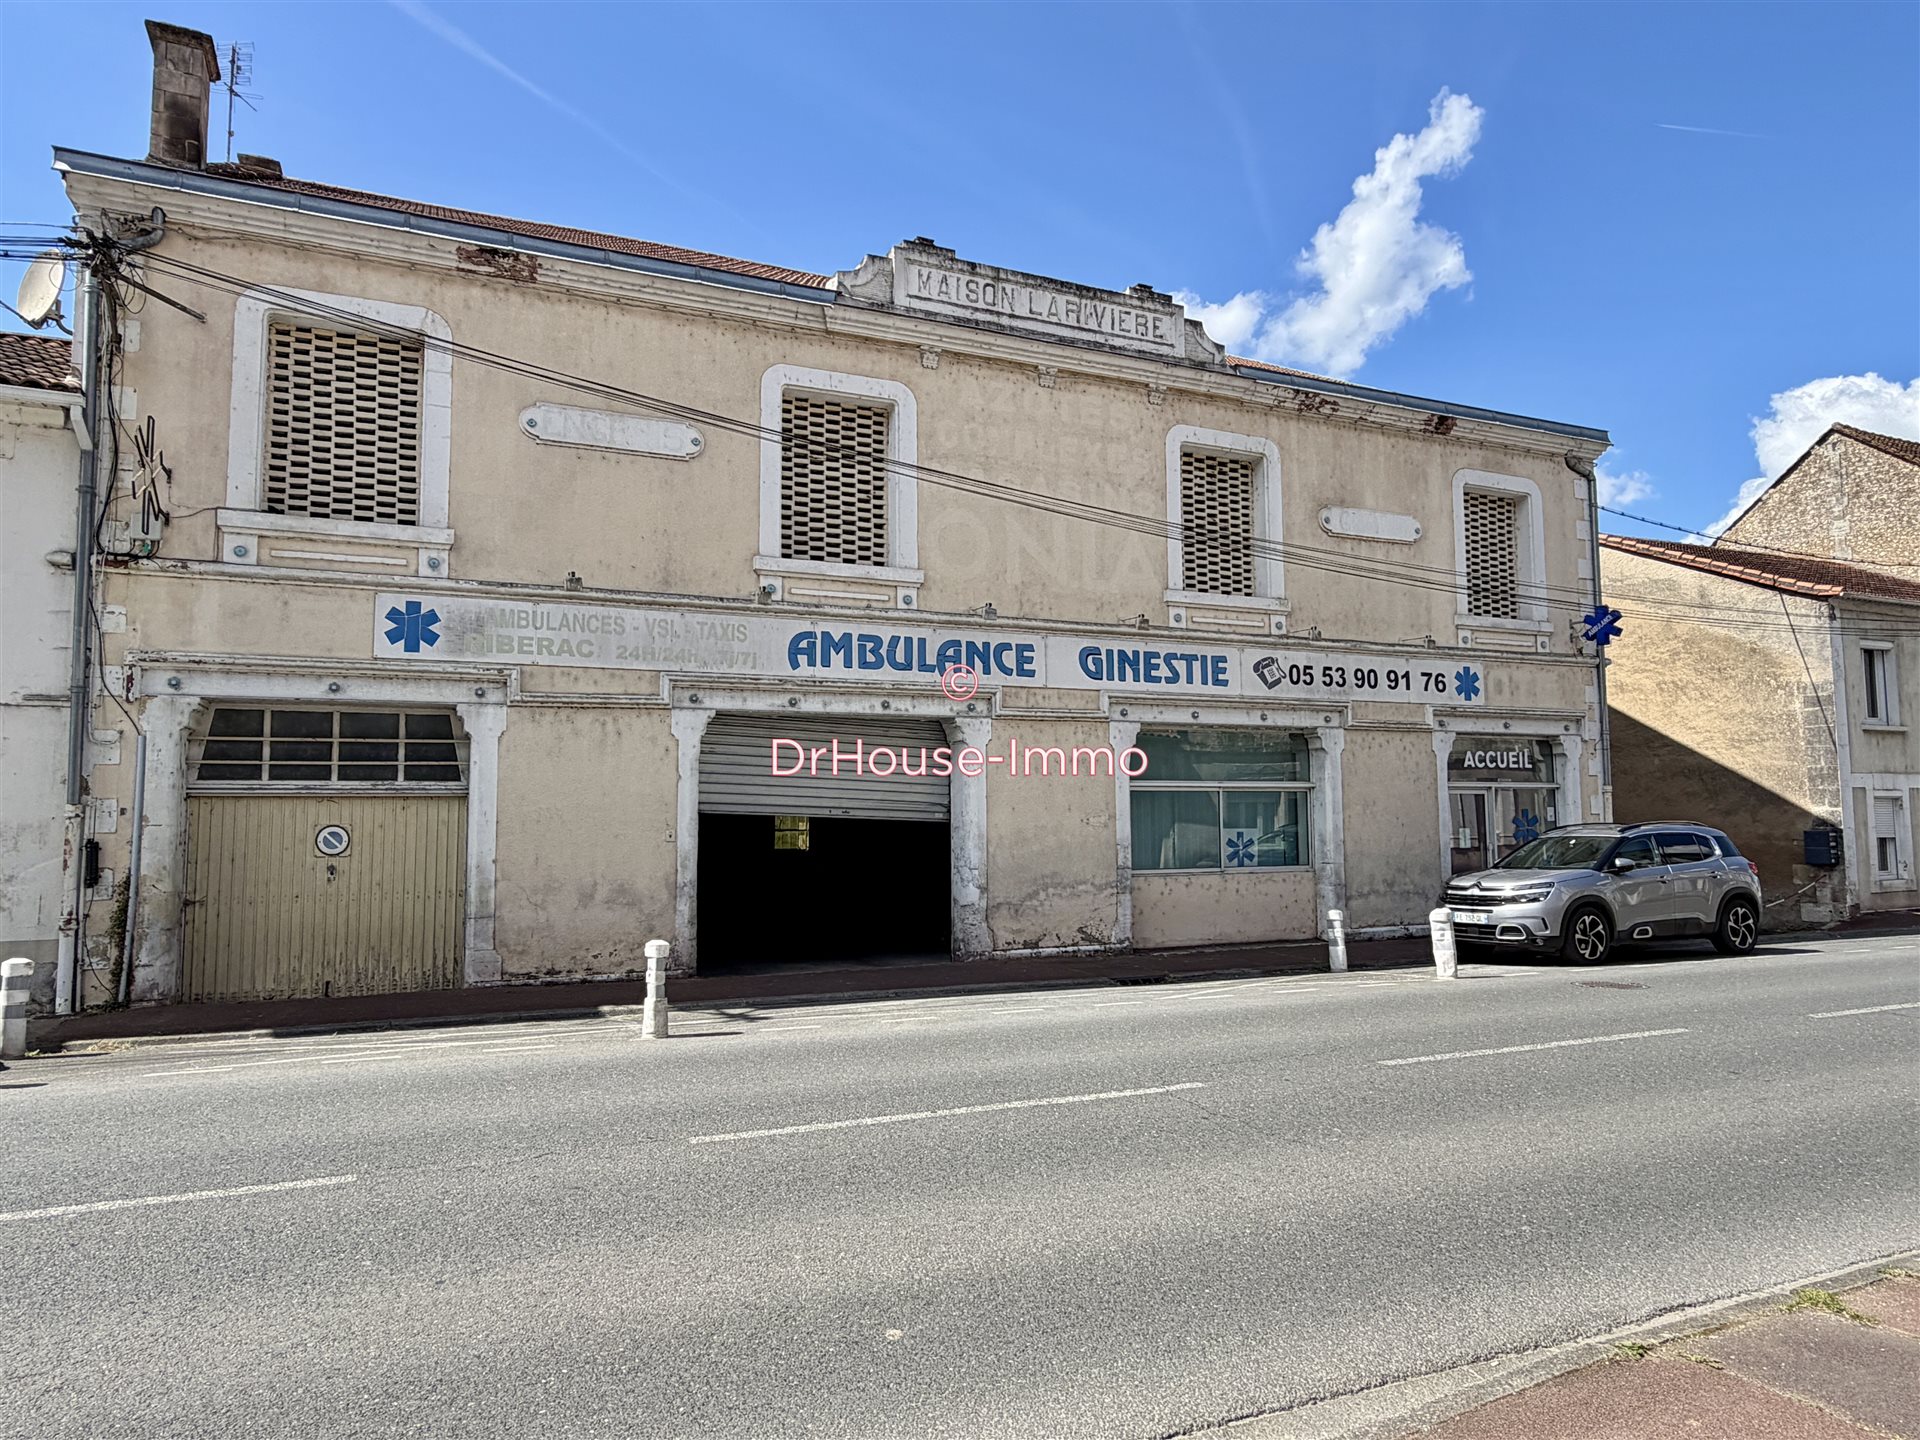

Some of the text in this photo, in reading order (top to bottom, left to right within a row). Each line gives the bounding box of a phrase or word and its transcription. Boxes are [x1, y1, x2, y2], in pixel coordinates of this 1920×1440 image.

[916, 267, 1165, 339] MAISON LARIVIERE
[696, 622, 748, 644] TAXIS
[787, 630, 1036, 678] AMBULANCE
[1078, 645, 1228, 688] GINESTIE
[1288, 664, 1447, 694] 05 53 90 91 76
[1463, 750, 1533, 770] ACCUEIL
